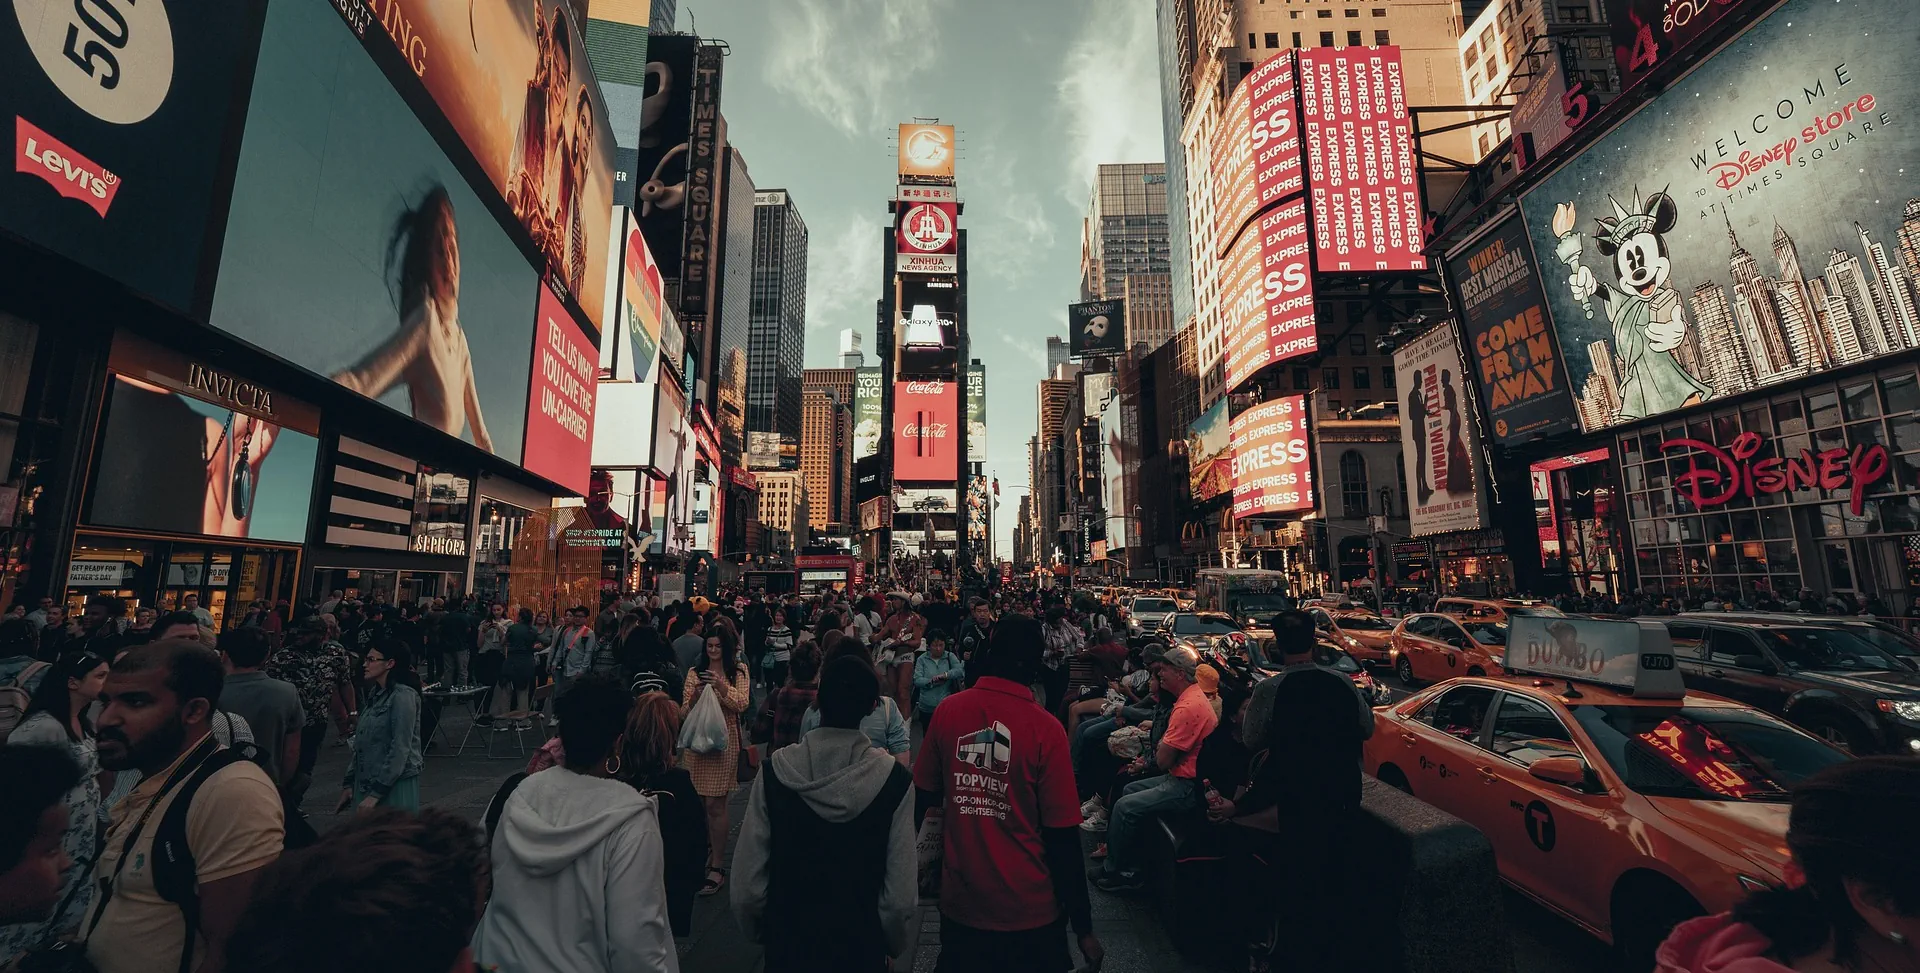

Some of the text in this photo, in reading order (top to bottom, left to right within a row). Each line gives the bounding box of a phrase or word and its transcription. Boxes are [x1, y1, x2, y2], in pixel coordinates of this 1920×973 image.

[1319, 64, 1335, 121] EXPRESS
[1354, 62, 1371, 120] EXPRESS
[1388, 62, 1404, 119] EXPRESS
[1690, 62, 1853, 171] WELCOME
[1214, 109, 1291, 206] EXPRESS
[1302, 59, 1330, 249] EXPRESS EXPRESS EXPRESS
[1326, 127, 1342, 186] EXPRESS
[1336, 58, 1366, 248] EXPRESS EXPRESS EXPRESS
[1361, 126, 1378, 185] EXPRESS
[1370, 57, 1402, 248] EXPRESS EXPRESS EXPRESS
[1395, 126, 1412, 185] EXPRESS
[1695, 188, 1707, 198] TO
[1801, 93, 1877, 145] store
[1700, 112, 1892, 220] AT TIMES SQUARE
[688, 68, 717, 282] TIMES SQUARE
[915, 238, 943, 249] XINHUA
[1332, 194, 1348, 255] EXPRESS
[1368, 192, 1386, 254] EXPRESS
[1403, 192, 1420, 253] EXPRESS
[910, 257, 944, 265] XINHUA
[1461, 272, 1483, 301] BEST
[1482, 247, 1527, 287] MUSICAL
[1468, 238, 1507, 275] WINNER!
[1078, 304, 1115, 314] PHANTOM
[1224, 263, 1306, 339] EXPRESS
[1464, 298, 1474, 311] ALL
[1474, 288, 1492, 305] ACROSS
[1491, 278, 1507, 295] NORTH
[1507, 266, 1530, 286] AMERICA
[900, 318, 933, 326] Galaxy
[1404, 347, 1420, 359] HAVE
[1425, 331, 1447, 347] REALLY
[1476, 304, 1546, 358] COME
[548, 317, 593, 386] TELL US WHY
[1398, 358, 1415, 372] GOOD
[1416, 351, 1429, 362] TIME
[187, 362, 272, 416] INVICTA
[543, 348, 592, 416] YOU LOVE THE
[1423, 364, 1441, 418] PRETTY
[1491, 359, 1554, 411] AWAY
[542, 386, 587, 442] UN-CARRIER
[1248, 402, 1292, 424] EXPRESS
[1249, 420, 1293, 441] EXPRESS
[1231, 439, 1307, 479] EXPRESS
[1253, 473, 1297, 490] EXPRESS
[1429, 427, 1448, 491] WOMAN
[1254, 492, 1299, 507] EXPRESS
[416, 534, 465, 556] SEPHORA
[70, 573, 99, 581] FATHER'S
[1644, 656, 1669, 668] 7J70
[954, 772, 1008, 793] TOPVIEW
[1510, 800, 1524, 812] NYC
[960, 806, 1006, 820] SIGHTSEEING
[1530, 808, 1549, 845] T
